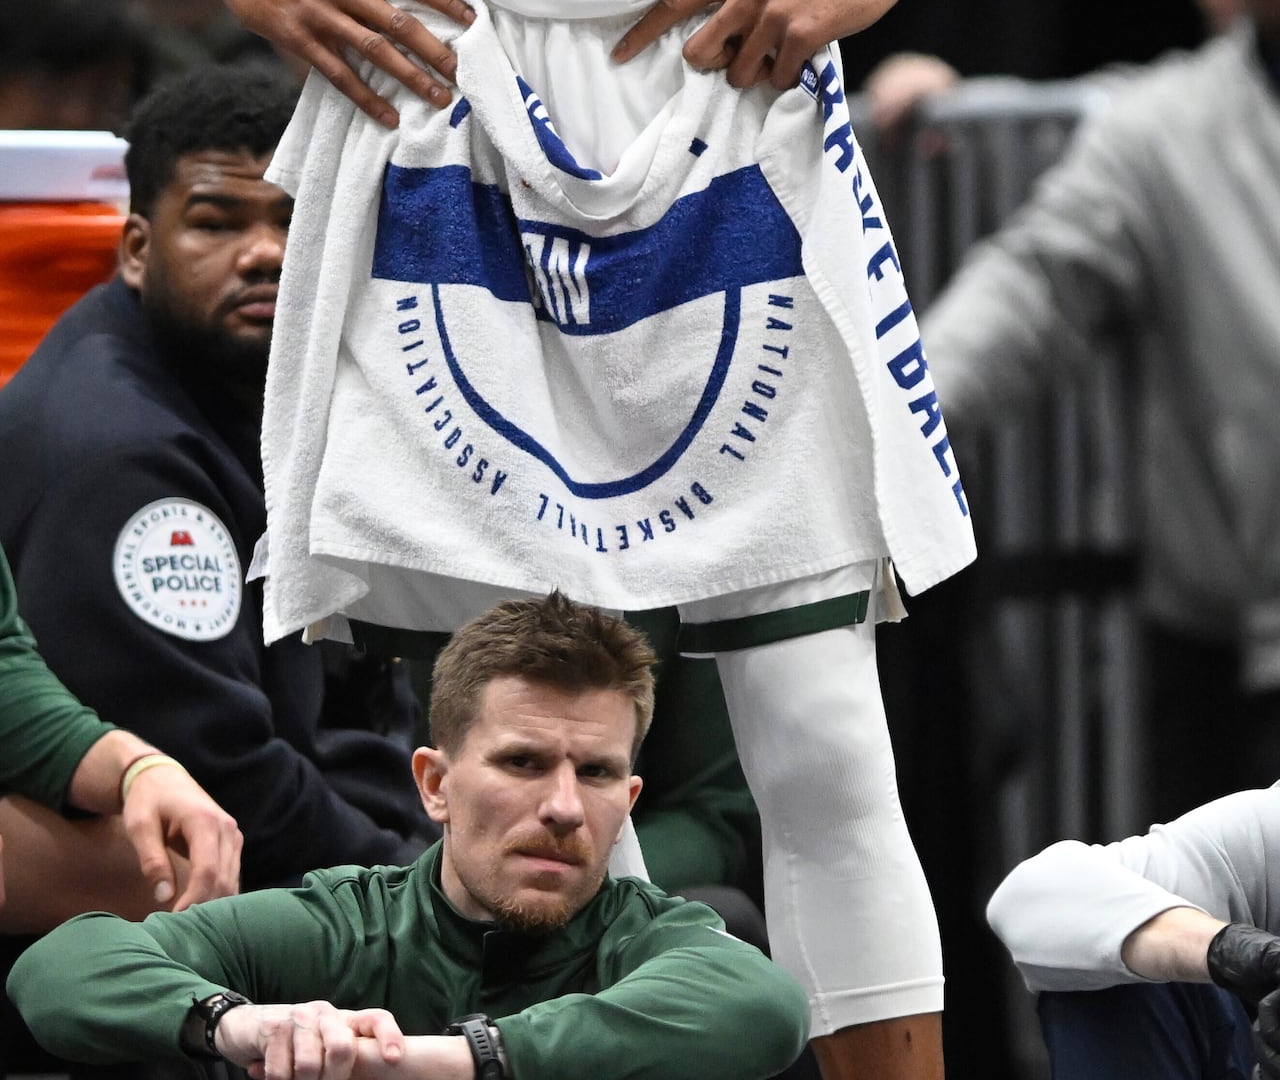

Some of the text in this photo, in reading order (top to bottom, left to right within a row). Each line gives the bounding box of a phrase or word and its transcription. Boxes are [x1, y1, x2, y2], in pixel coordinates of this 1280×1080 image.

[395, 293, 794, 554] NATIONAL BASKETLL ASSOCIATION
[141, 553, 224, 574] SPECIAL
[151, 575, 222, 593] POLICE
